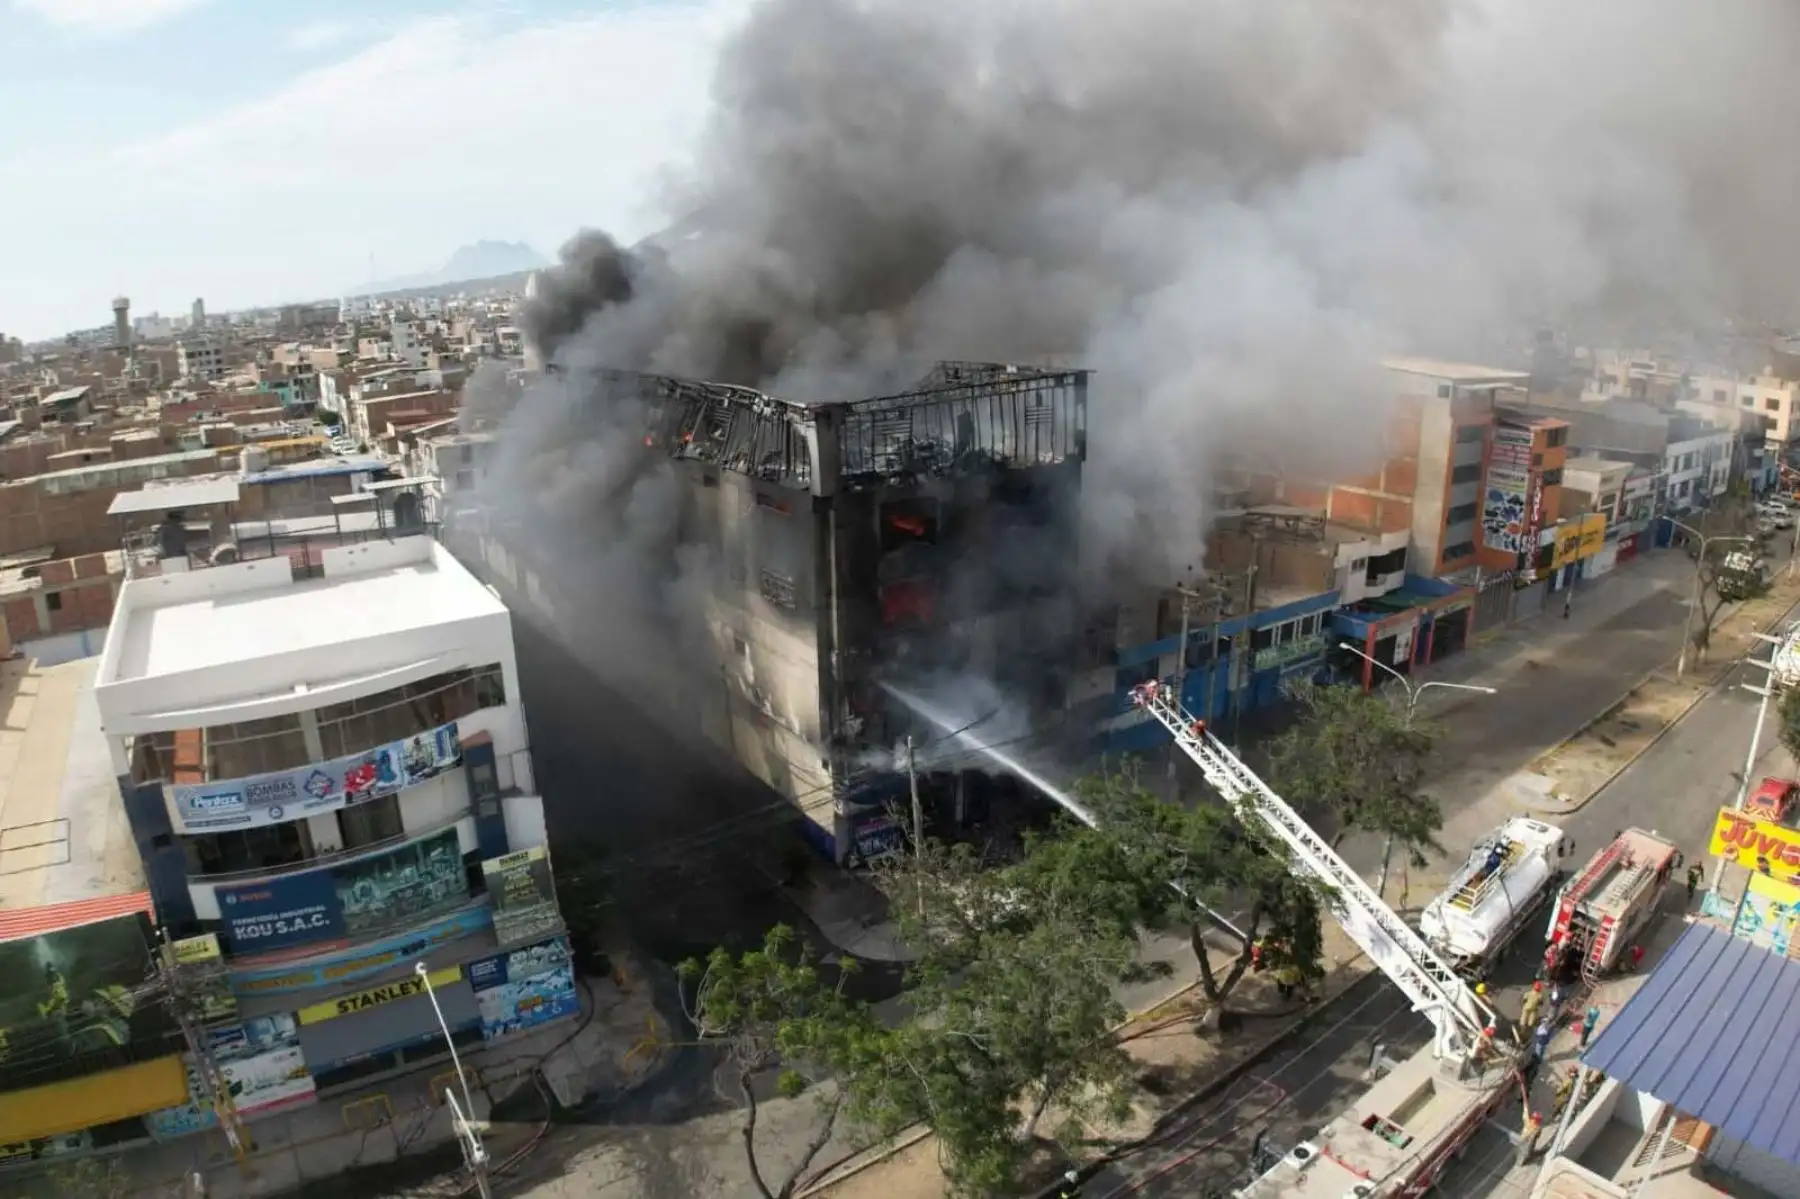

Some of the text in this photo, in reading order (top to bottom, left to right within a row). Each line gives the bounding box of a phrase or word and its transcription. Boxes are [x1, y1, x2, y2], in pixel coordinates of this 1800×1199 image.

[234, 913, 331, 940] KOU S.A.C.
[337, 979, 424, 1014] STANLEY
